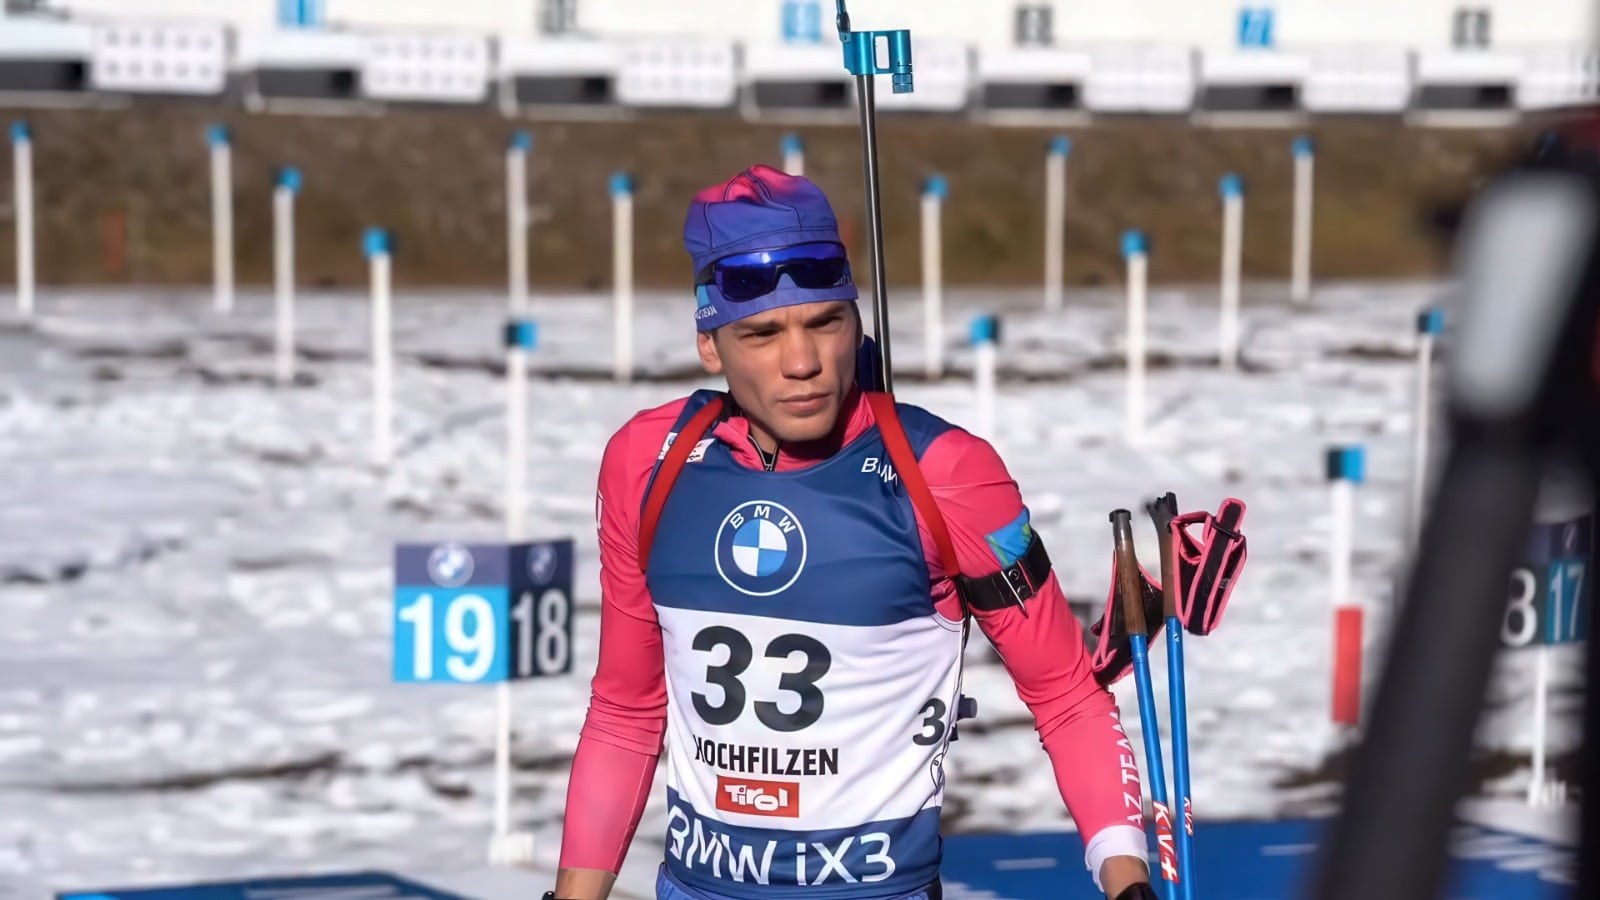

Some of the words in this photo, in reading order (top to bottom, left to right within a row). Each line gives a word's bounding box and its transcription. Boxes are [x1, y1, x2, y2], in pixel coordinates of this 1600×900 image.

[729, 505, 797, 534] BMW
[398, 594, 495, 682] 19
[511, 588, 568, 677] 18
[1550, 563, 1585, 643] 17
[691, 625, 832, 732] 33
[796, 832, 896, 886] iX3
